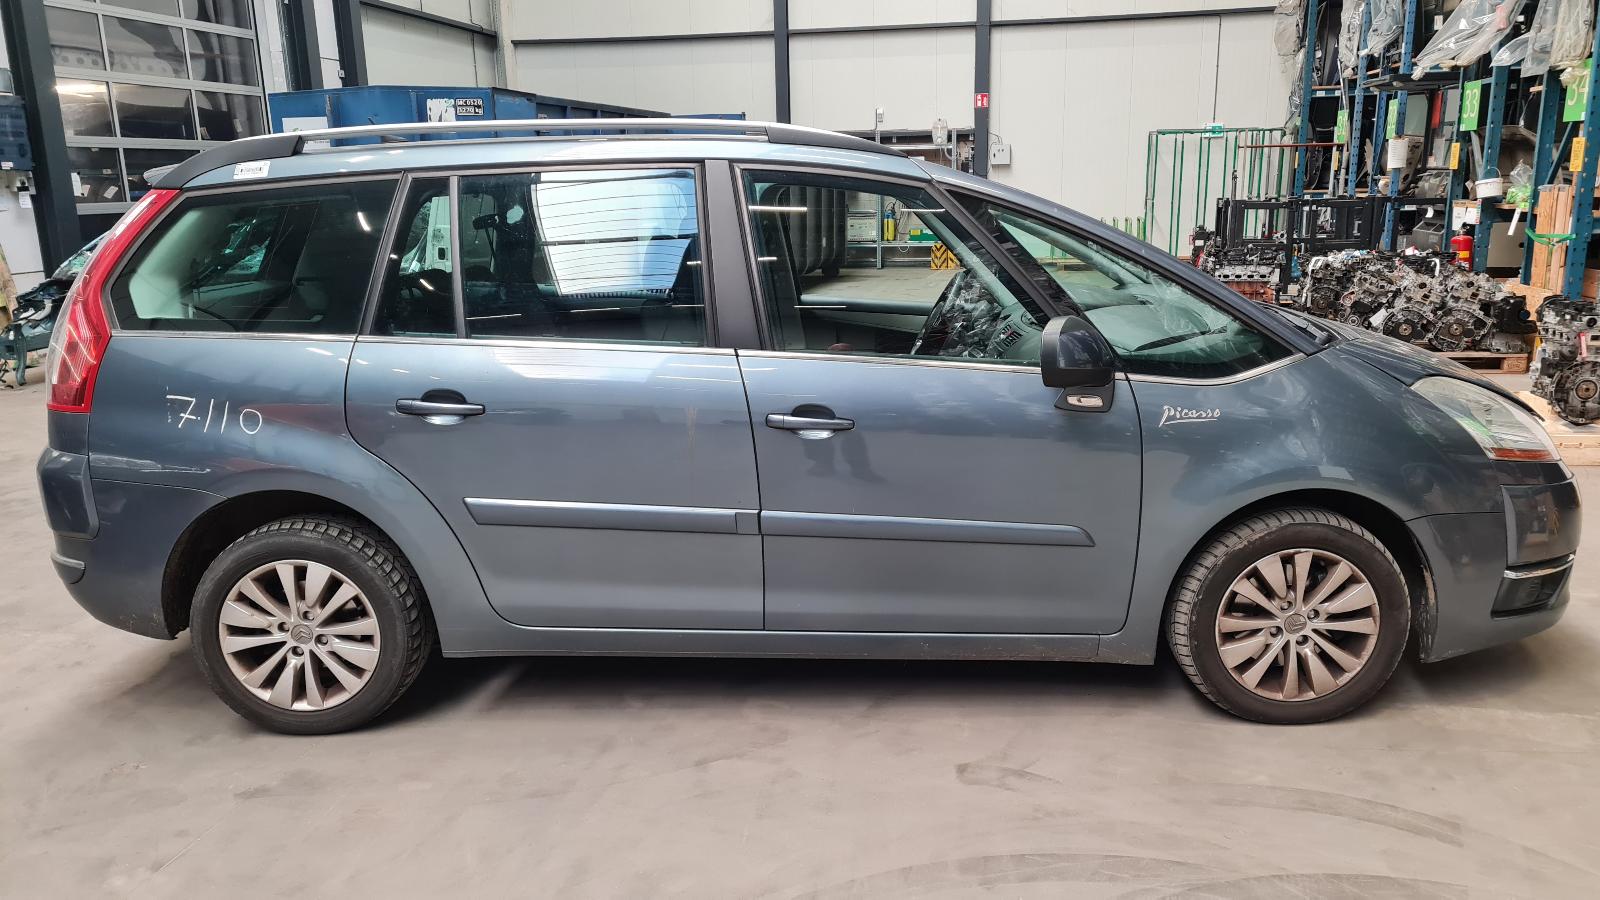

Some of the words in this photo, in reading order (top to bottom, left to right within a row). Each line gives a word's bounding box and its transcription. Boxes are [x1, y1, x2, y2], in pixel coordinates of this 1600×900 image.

[1462, 88, 1479, 119] 33
[1567, 71, 1590, 106] 34
[1158, 404, 1221, 428] Picasso
